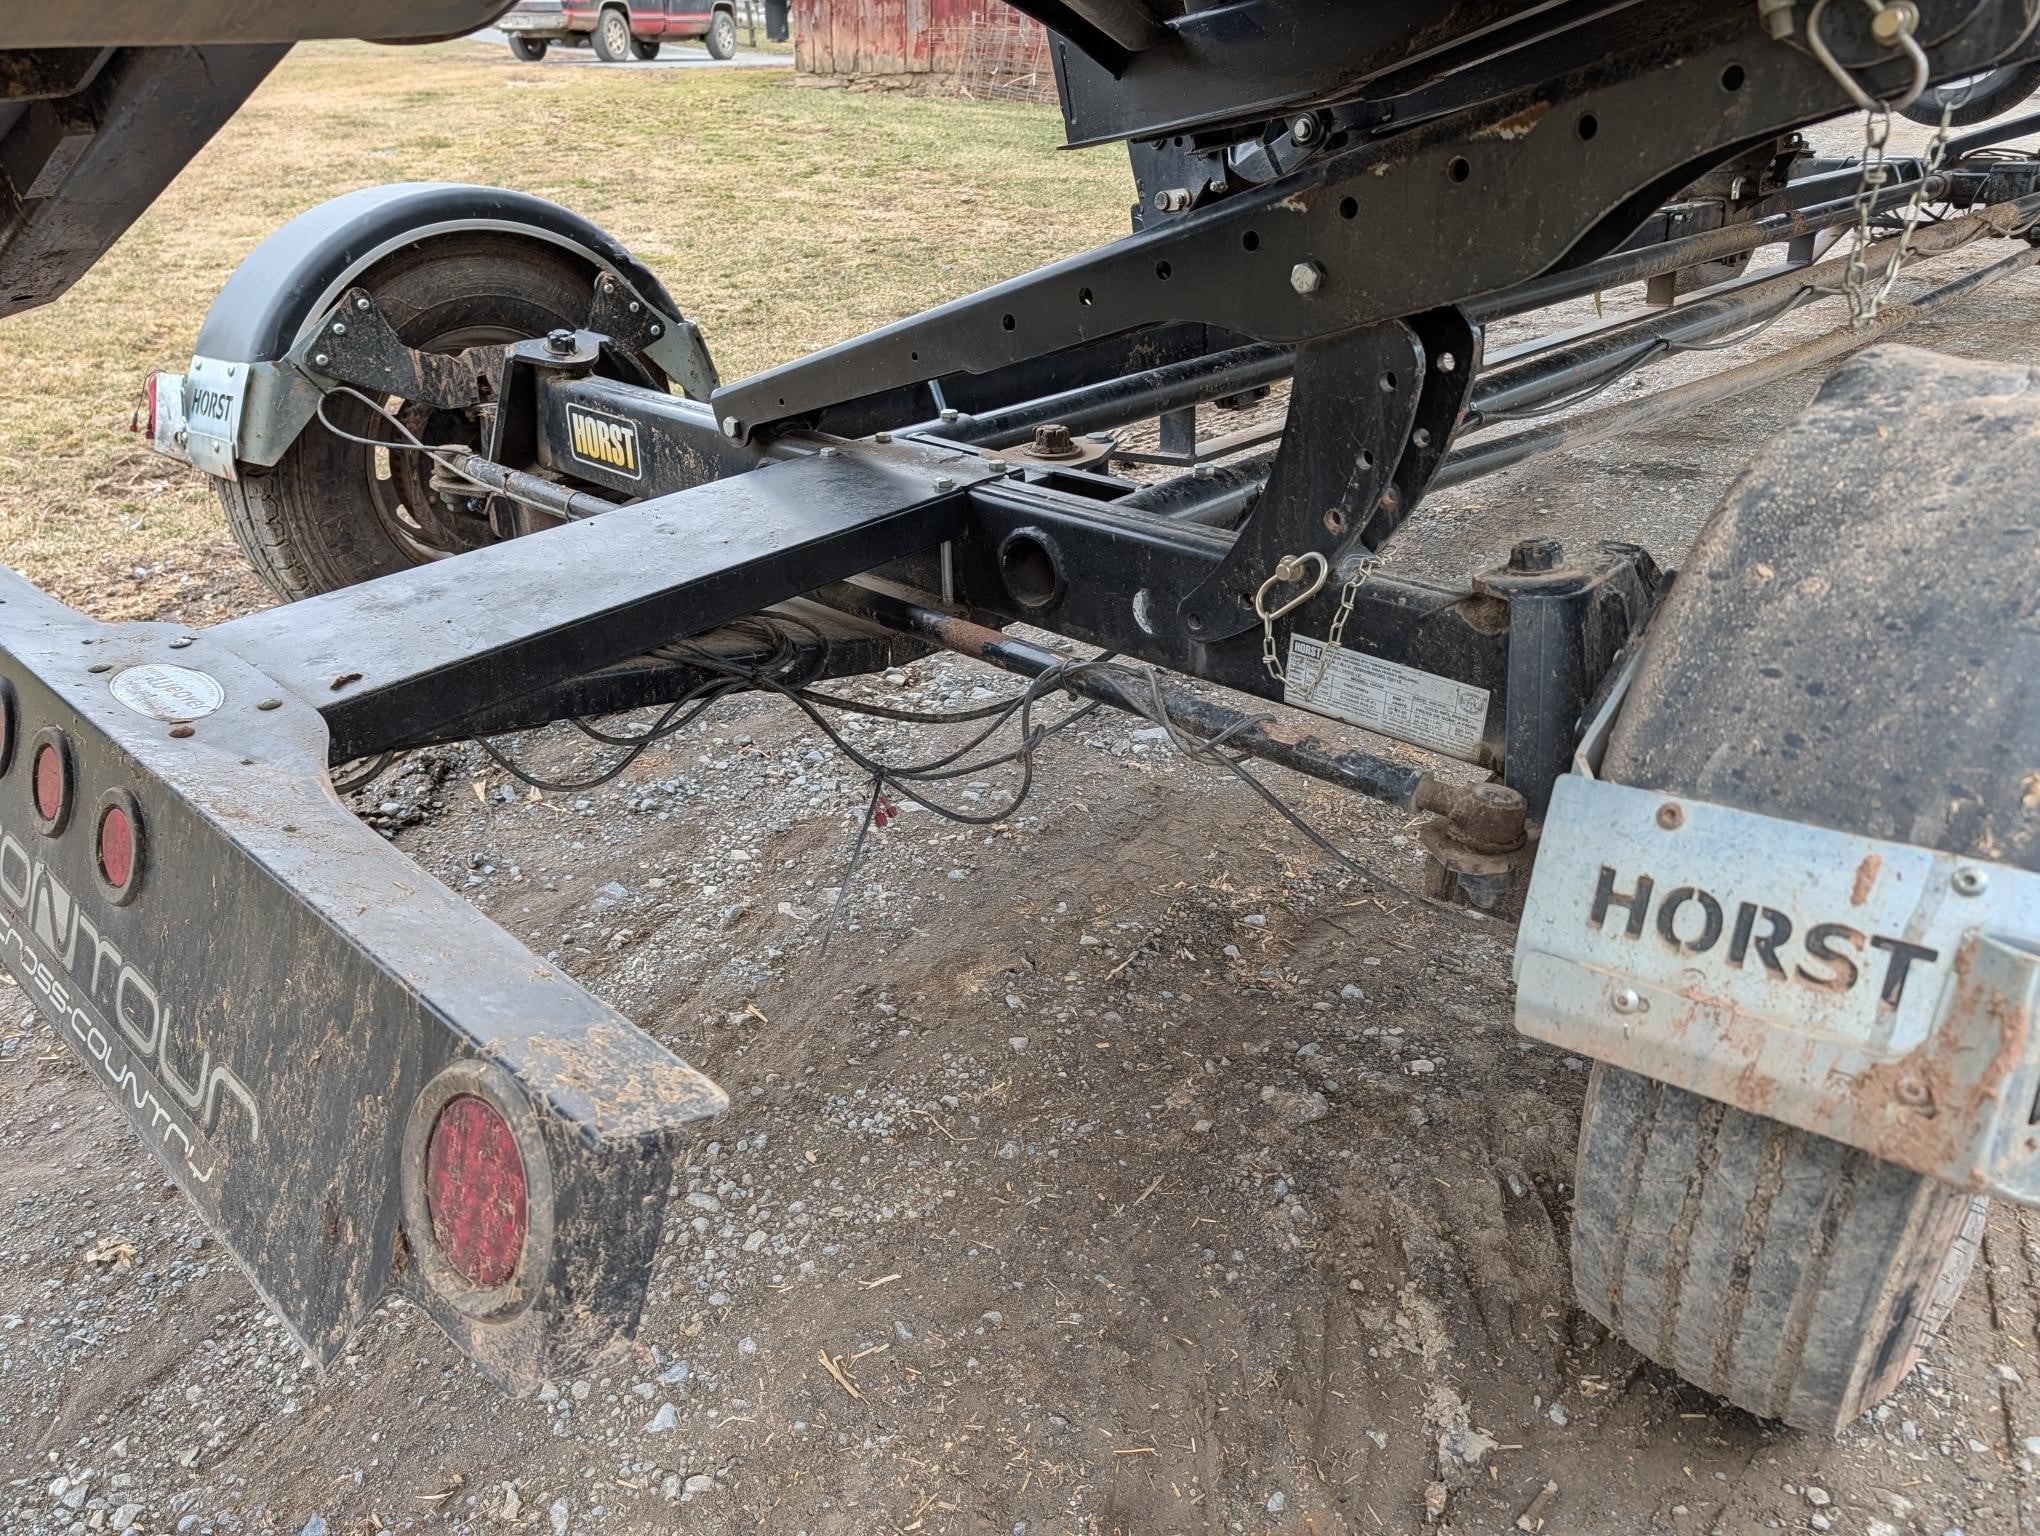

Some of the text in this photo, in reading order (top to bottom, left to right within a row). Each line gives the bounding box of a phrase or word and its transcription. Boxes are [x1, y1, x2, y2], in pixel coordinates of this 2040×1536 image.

[192, 388, 234, 422] HORST
[571, 412, 635, 470] HORST
[1294, 640, 1321, 659] HORST
[1586, 864, 1938, 1012] HORST
[0, 825, 259, 1142] ONTOUR
